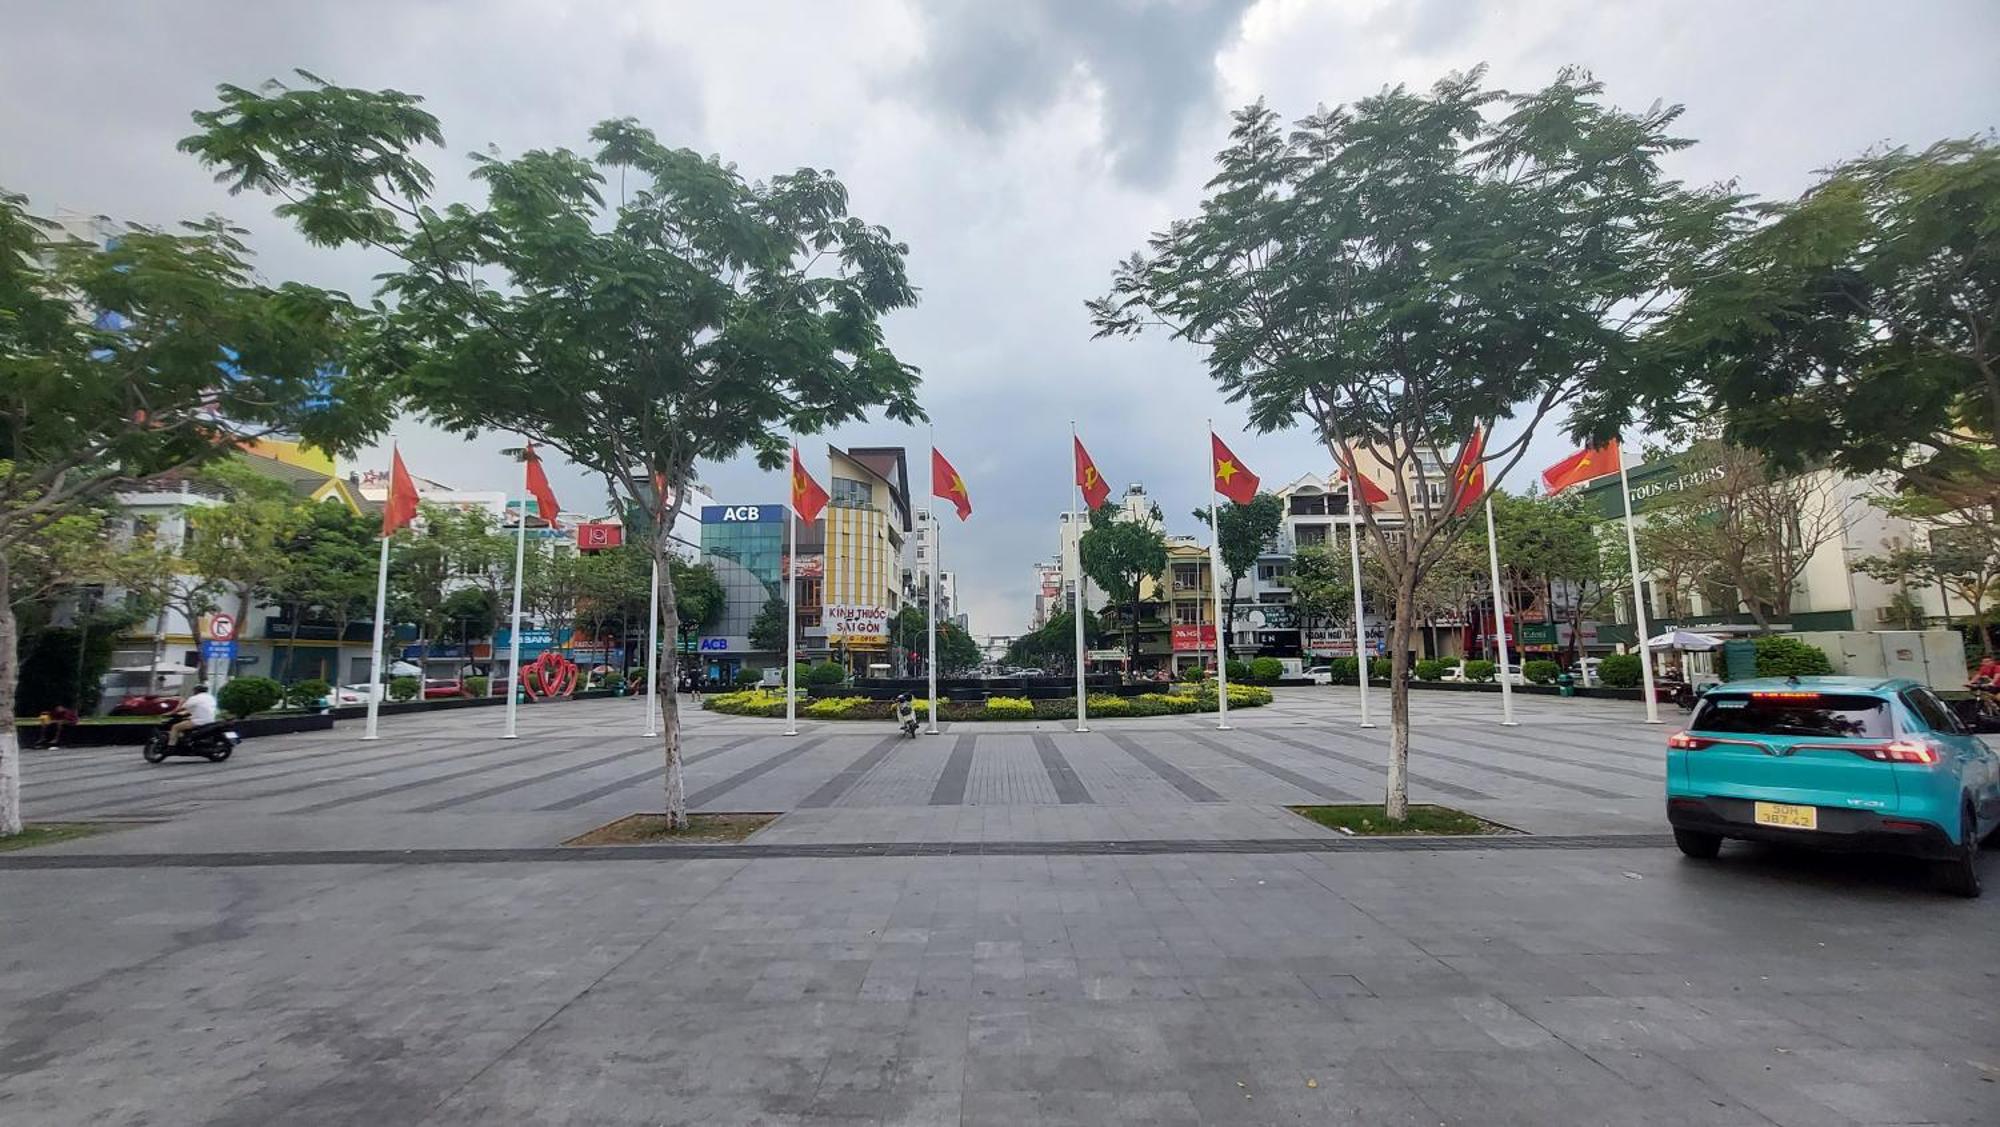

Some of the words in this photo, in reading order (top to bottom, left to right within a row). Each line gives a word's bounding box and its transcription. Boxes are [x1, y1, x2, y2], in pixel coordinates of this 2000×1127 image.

[1629, 482, 1662, 501] TOUS
[723, 507, 759, 521] ACB
[829, 604, 854, 618] KÍNH
[856, 606, 886, 619] THUỐC
[857, 620, 879, 633] GÒN
[701, 639, 728, 650] ACB
